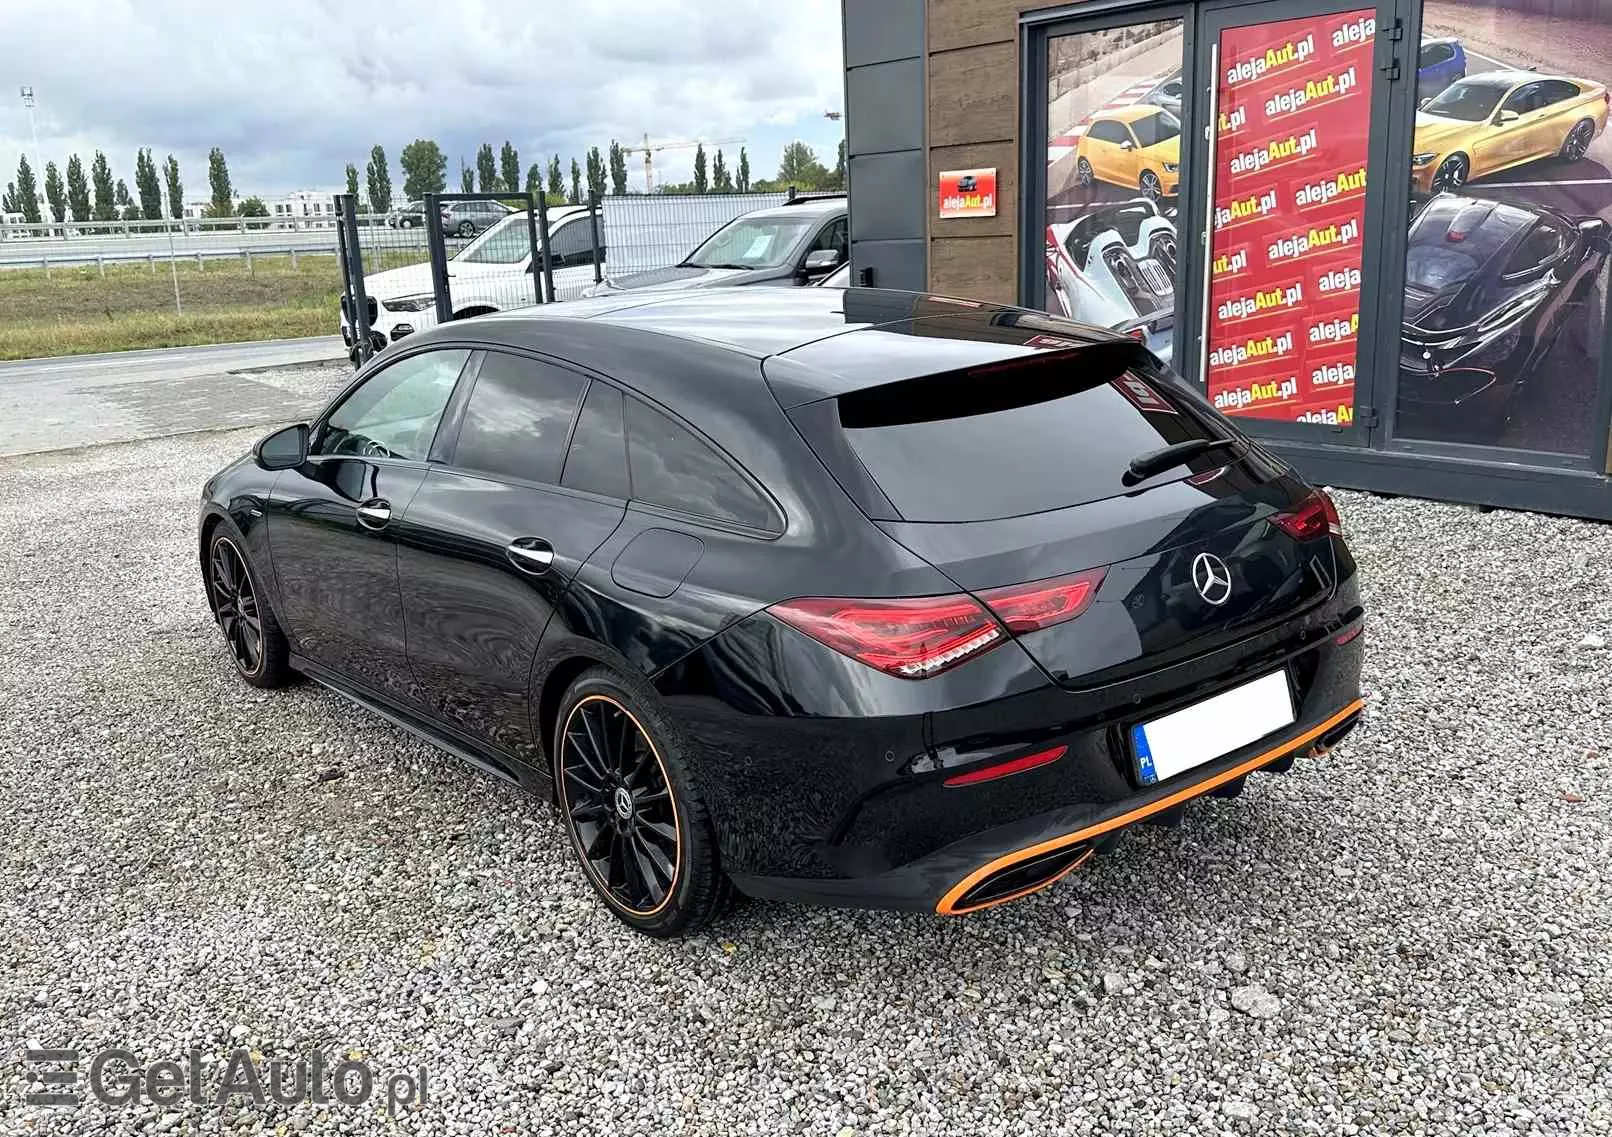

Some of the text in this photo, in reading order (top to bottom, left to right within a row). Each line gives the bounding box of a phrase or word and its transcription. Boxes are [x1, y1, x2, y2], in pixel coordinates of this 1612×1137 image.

[1332, 18, 1376, 47] aleja
[1227, 34, 1315, 84] alejaAut.pl
[1265, 67, 1356, 116] alejaAut.pl
[1230, 129, 1317, 174] alejaAut.pl
[943, 193, 993, 210] alejaAut.pl
[1296, 167, 1367, 206] alejaAut
[1215, 190, 1277, 228] jaAut.pl
[1268, 219, 1358, 259] alejaAut.pl
[1319, 268, 1361, 292] aleja
[1218, 283, 1303, 319] alejaAut.pl
[1209, 332, 1293, 366] alejaAut.pl
[1312, 363, 1354, 385] aleja
[1214, 376, 1298, 408] alejaAut.pl
[1140, 756, 1153, 768] PL
